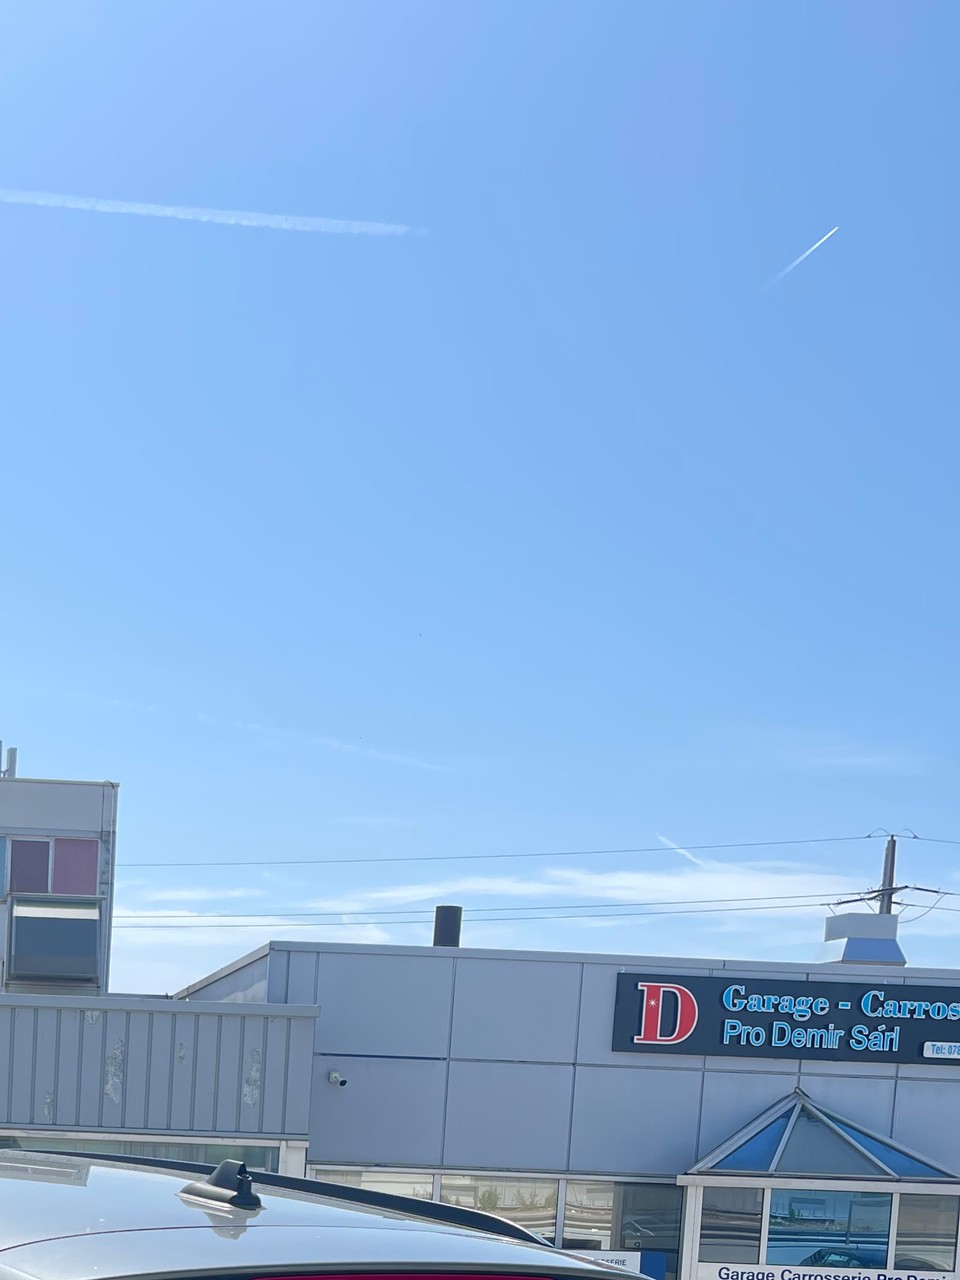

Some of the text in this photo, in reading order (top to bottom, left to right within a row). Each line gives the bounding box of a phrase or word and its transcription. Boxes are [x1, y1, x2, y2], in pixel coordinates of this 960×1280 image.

[633, 981, 699, 1045] D
[722, 984, 830, 1021] Garage
[860, 990, 960, 1021] Carros
[723, 1019, 766, 1047] Pro
[771, 1020, 844, 1049] Demir
